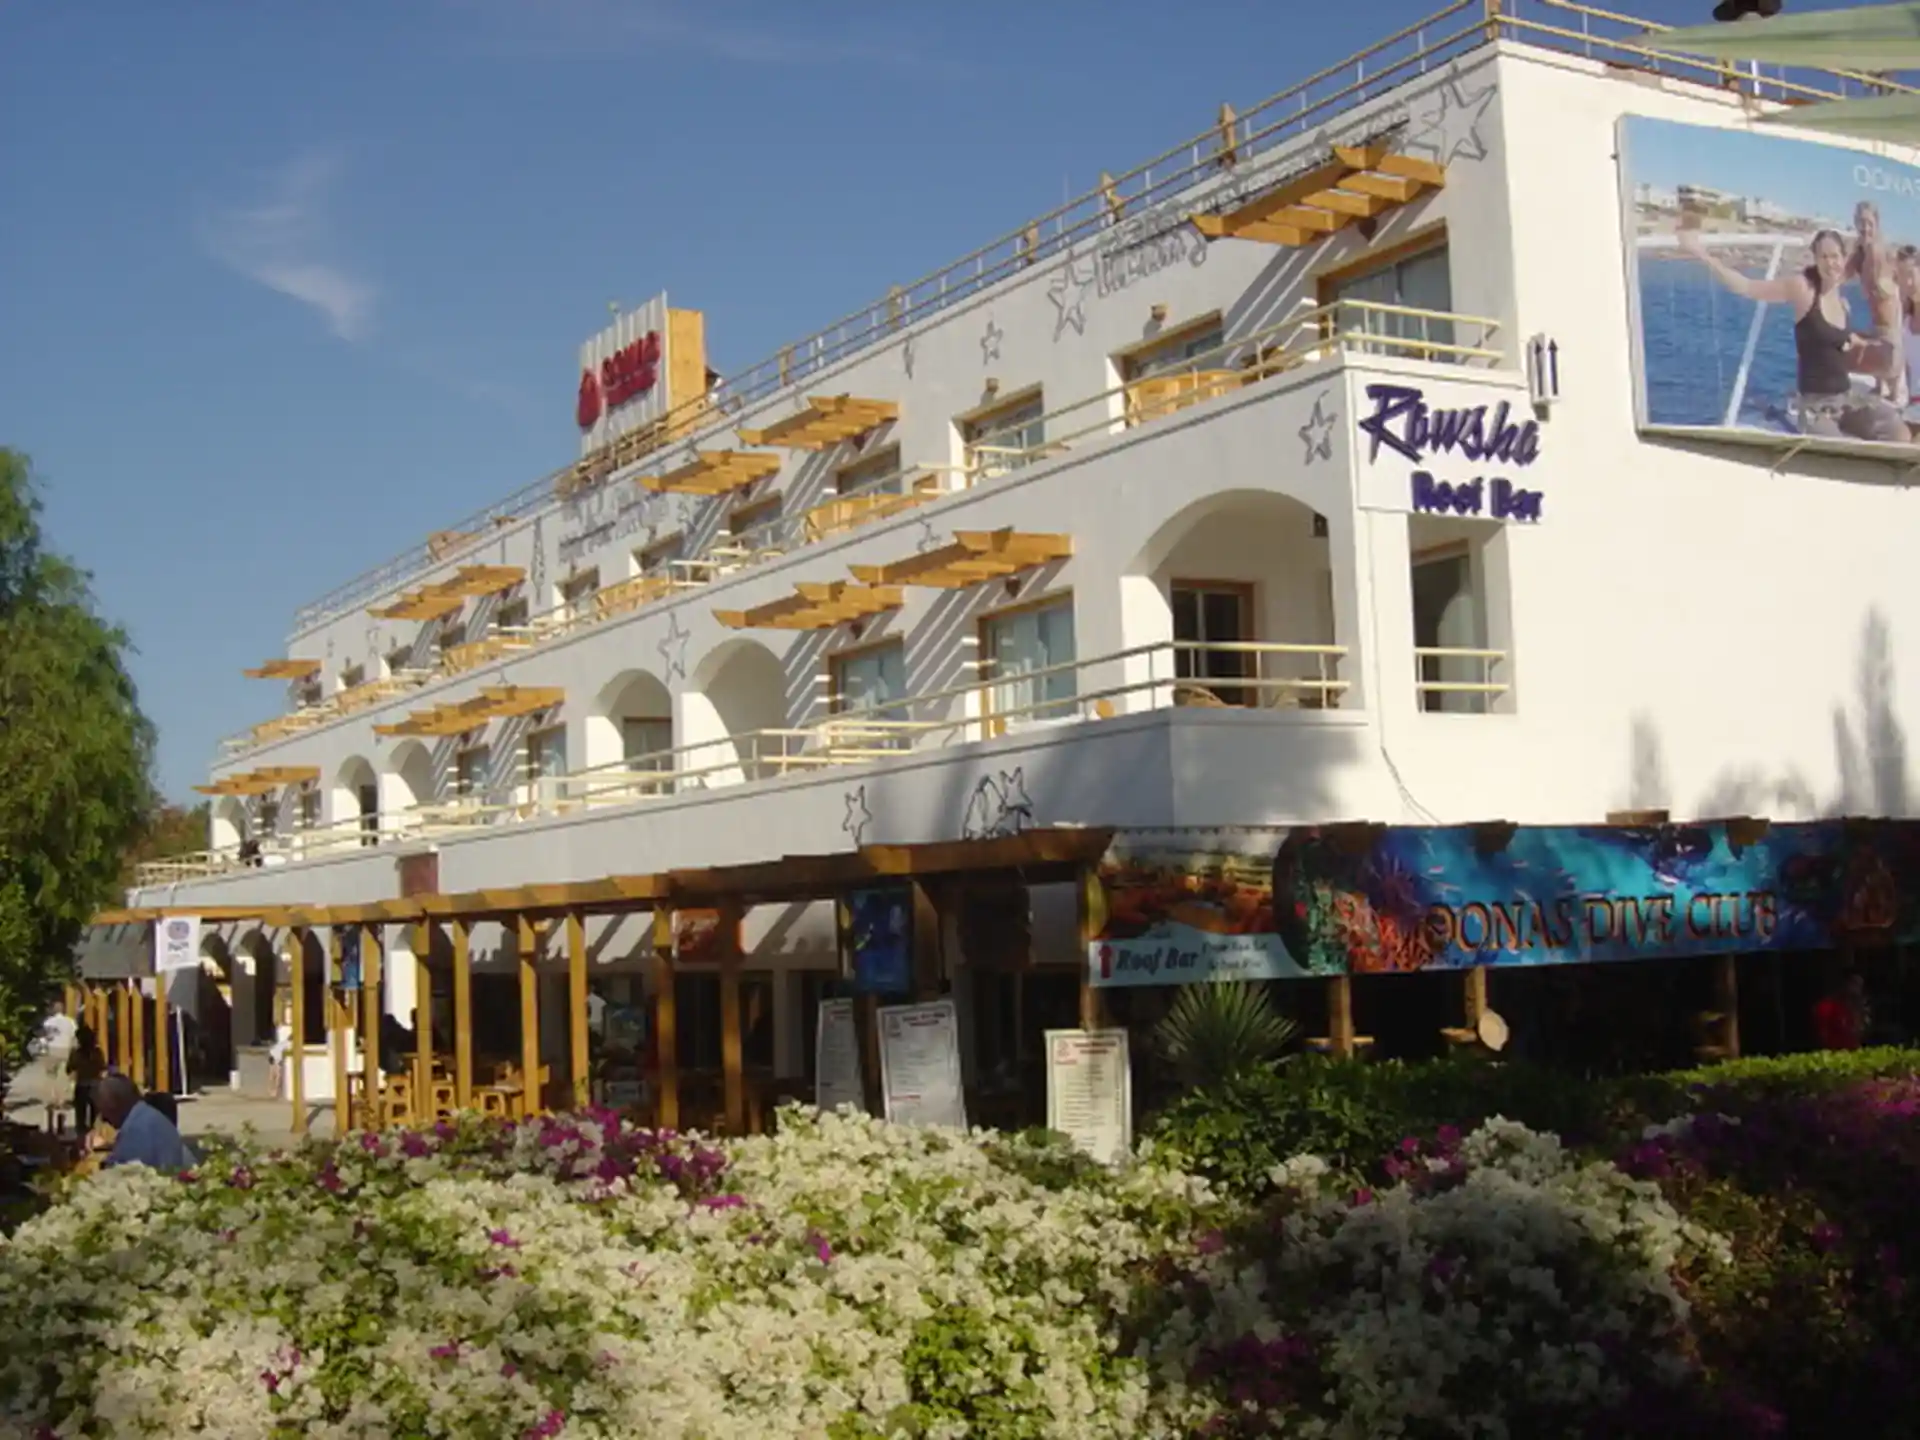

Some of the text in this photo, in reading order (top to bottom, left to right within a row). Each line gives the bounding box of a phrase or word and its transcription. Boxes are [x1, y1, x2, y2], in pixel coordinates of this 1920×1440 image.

[1489, 477, 1544, 522] Bar
[1584, 893, 1677, 945] DIVE
[1686, 890, 1779, 941] CLUB
[1116, 948, 1163, 976] Roof
[1165, 946, 1199, 970] Bar
